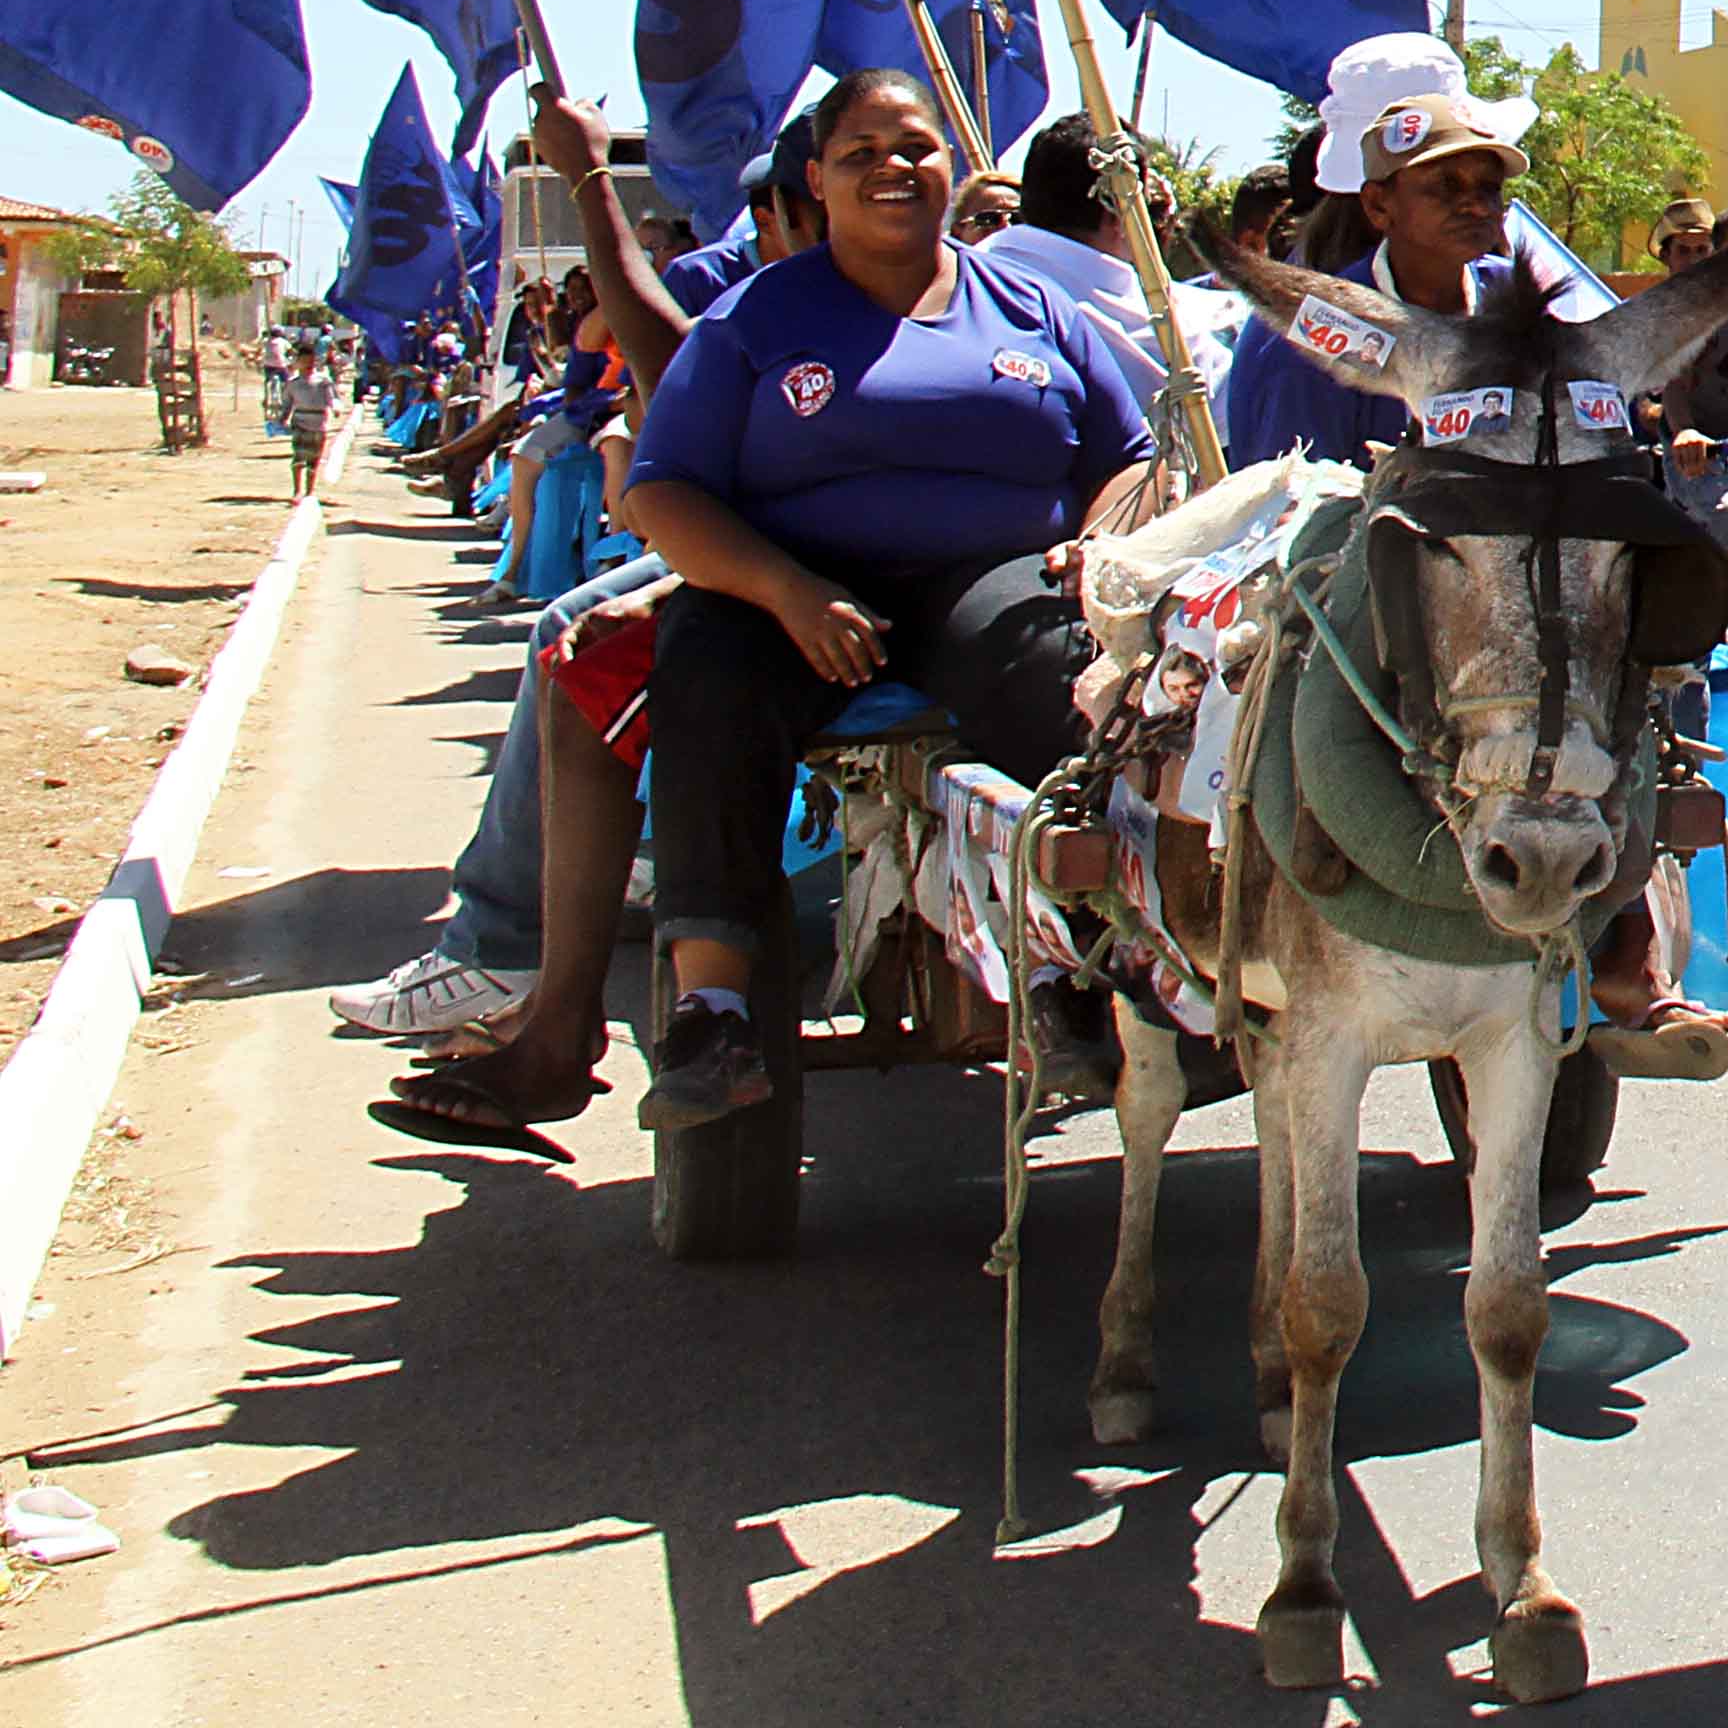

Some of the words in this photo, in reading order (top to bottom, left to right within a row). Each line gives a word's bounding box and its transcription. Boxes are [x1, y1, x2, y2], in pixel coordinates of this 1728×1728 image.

[1308, 325, 1349, 355] 40
[801, 372, 825, 399] 40
[1438, 408, 1471, 437] 40
[1589, 399, 1618, 423] 40
